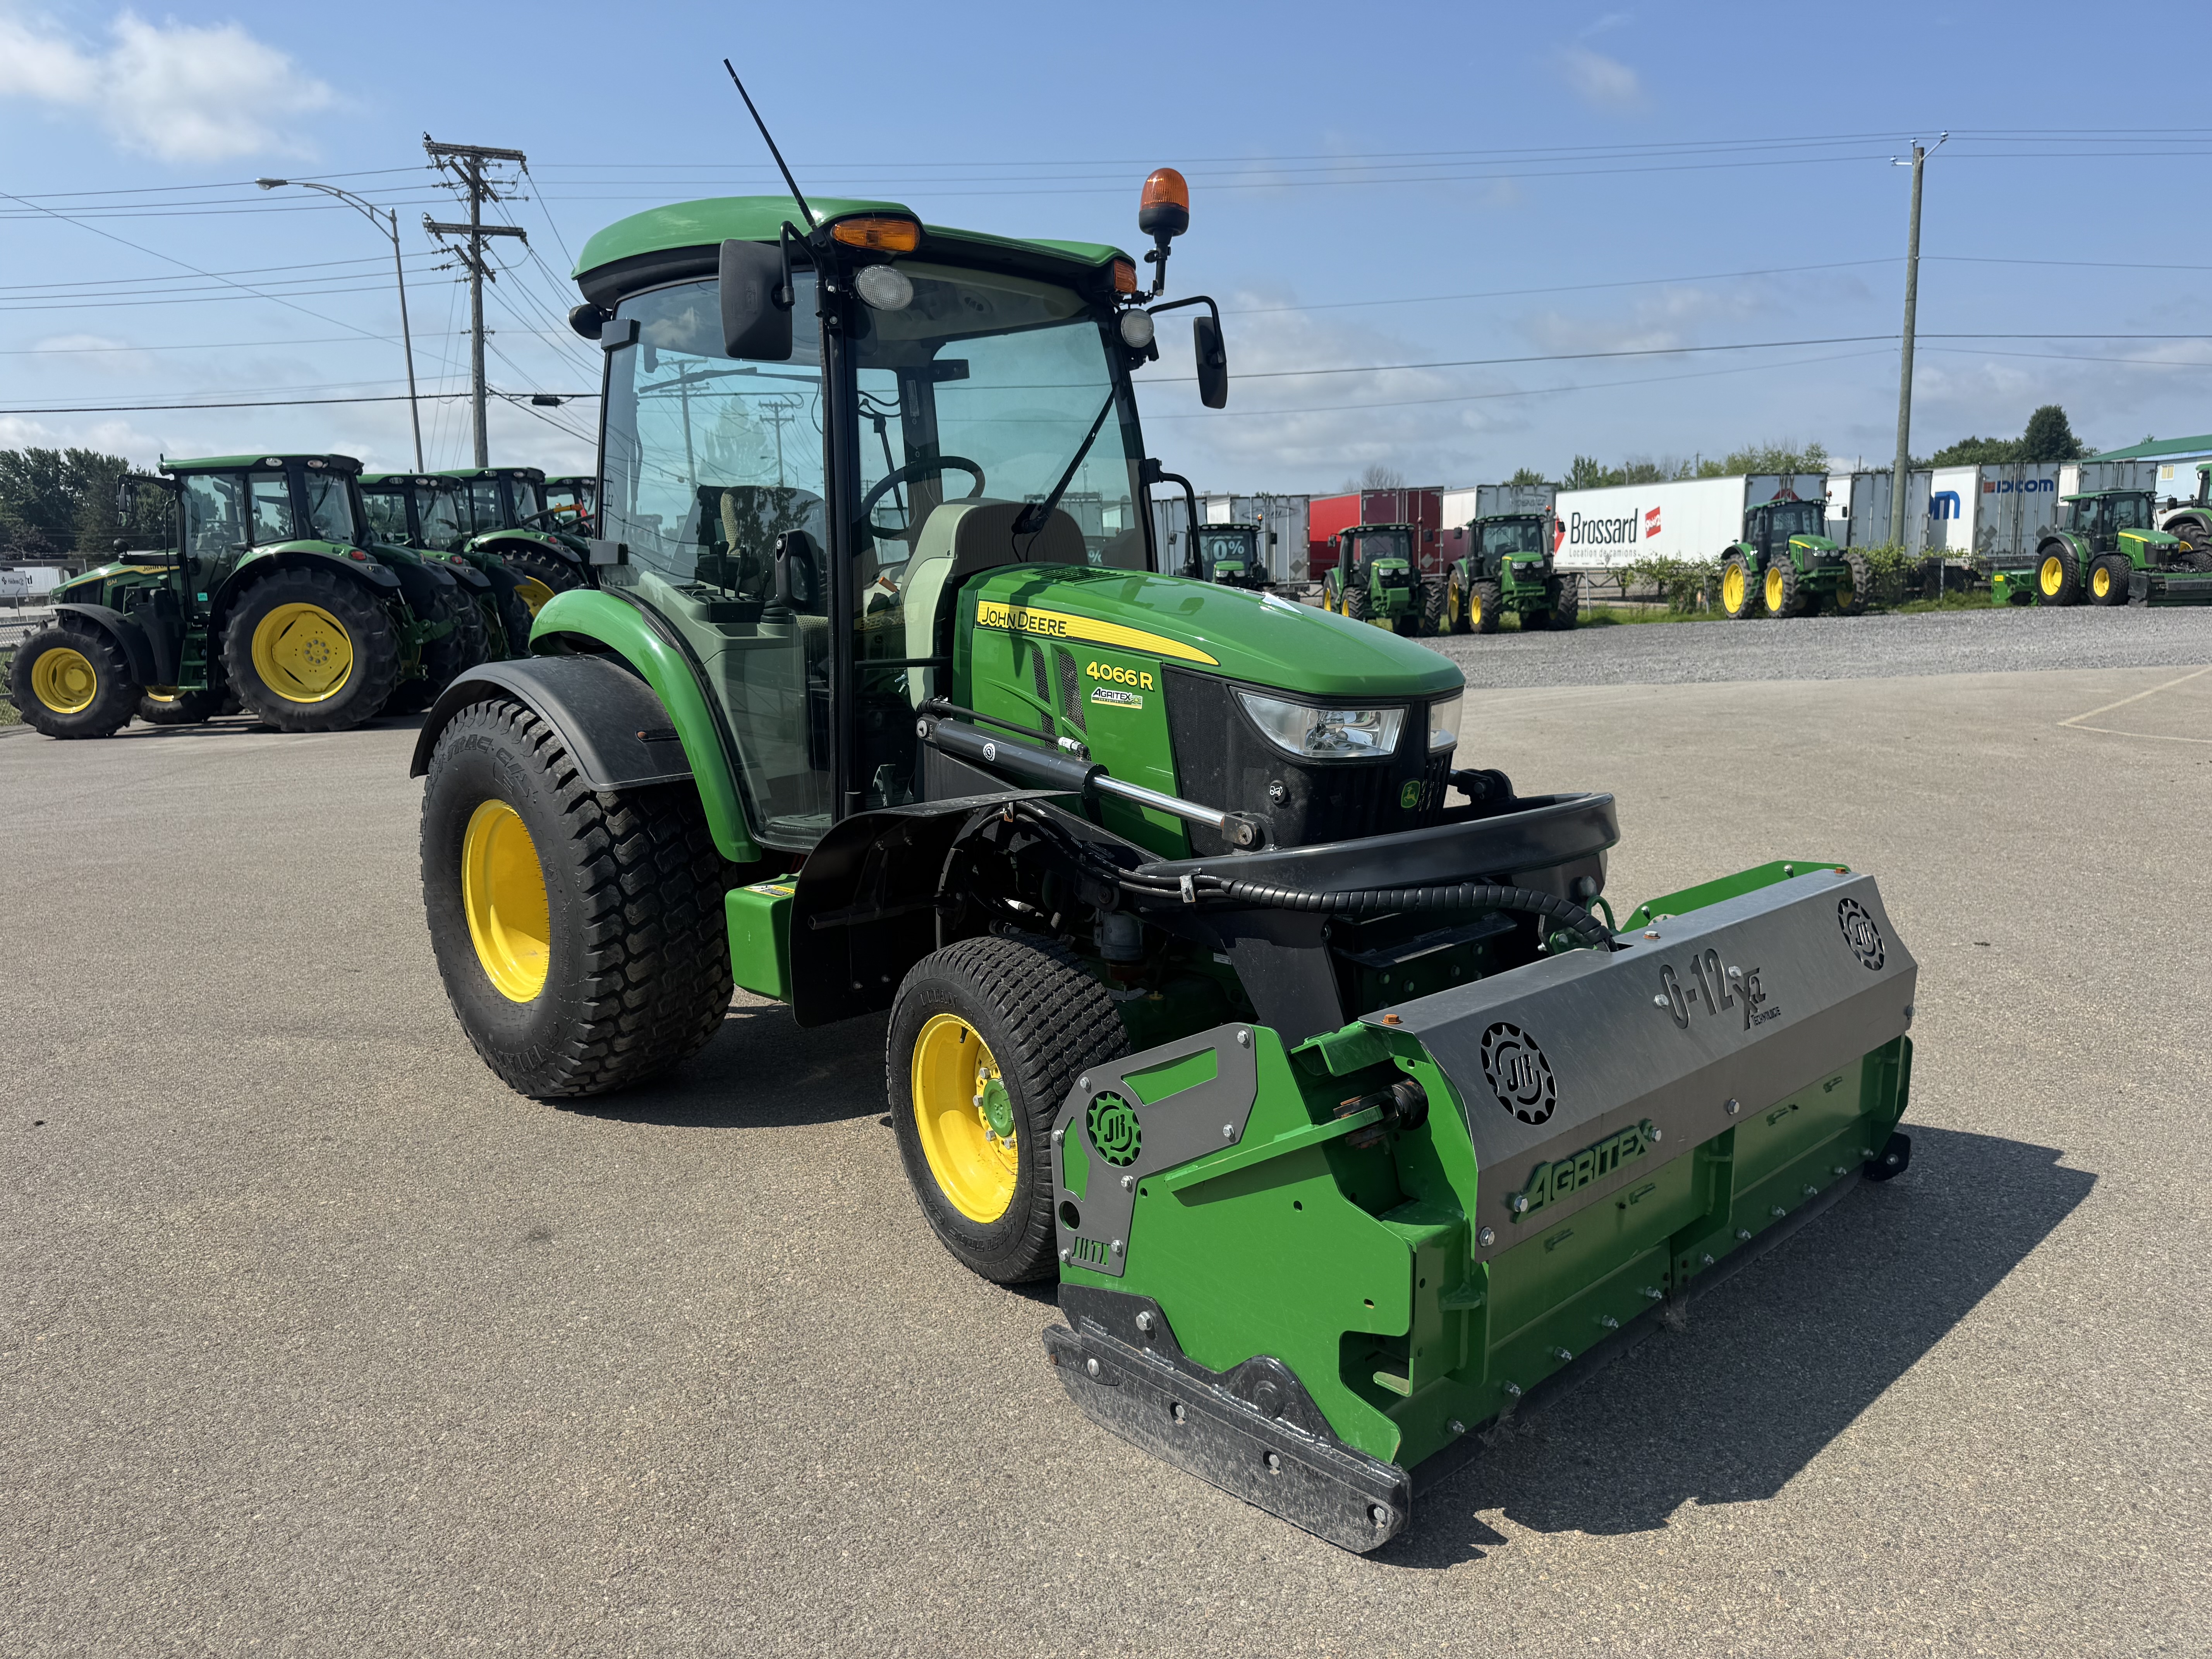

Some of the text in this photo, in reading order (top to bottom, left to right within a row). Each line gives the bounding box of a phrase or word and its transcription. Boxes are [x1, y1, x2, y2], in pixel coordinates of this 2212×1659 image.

[1570, 508, 1638, 544] Brossard
[1213, 540, 1245, 560] 0%
[1569, 548, 1637, 558] Location de camions
[982, 606, 1067, 635] JOHN DEERE
[1086, 661, 1154, 691] 4066R
[1093, 688, 1131, 701] AGRITEX
[917, 988, 958, 1008] TITAN
[1659, 948, 1735, 1030] 6-12
[1511, 1118, 1652, 1224] AGRITEX
